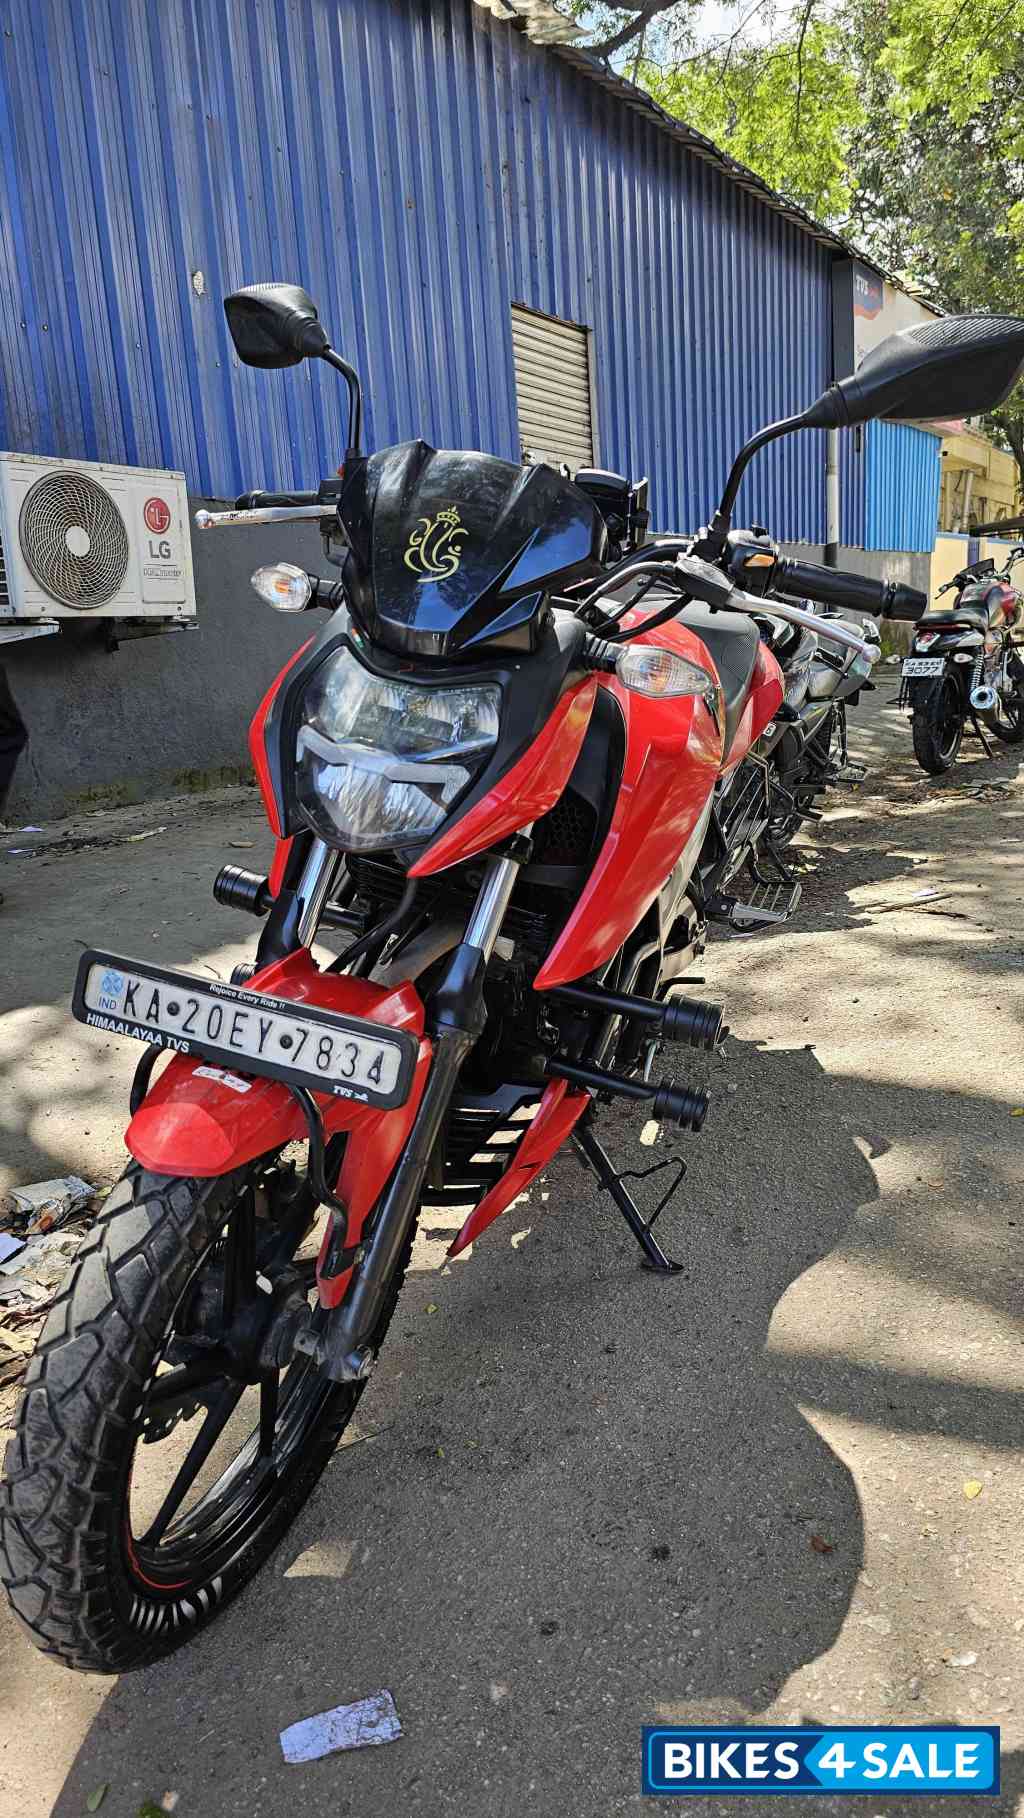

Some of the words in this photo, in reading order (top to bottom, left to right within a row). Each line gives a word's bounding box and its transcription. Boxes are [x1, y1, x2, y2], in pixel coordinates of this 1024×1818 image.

[148, 540, 171, 559] LG
[99, 996, 117, 1010] IND
[209, 984, 237, 997] Rejoice
[237, 991, 259, 1004] Every
[260, 998, 277, 1008] Ride
[86, 1013, 162, 1046] HIMAALAYAA
[167, 1037, 191, 1052] TVS
[334, 1085, 353, 1098] TVS
